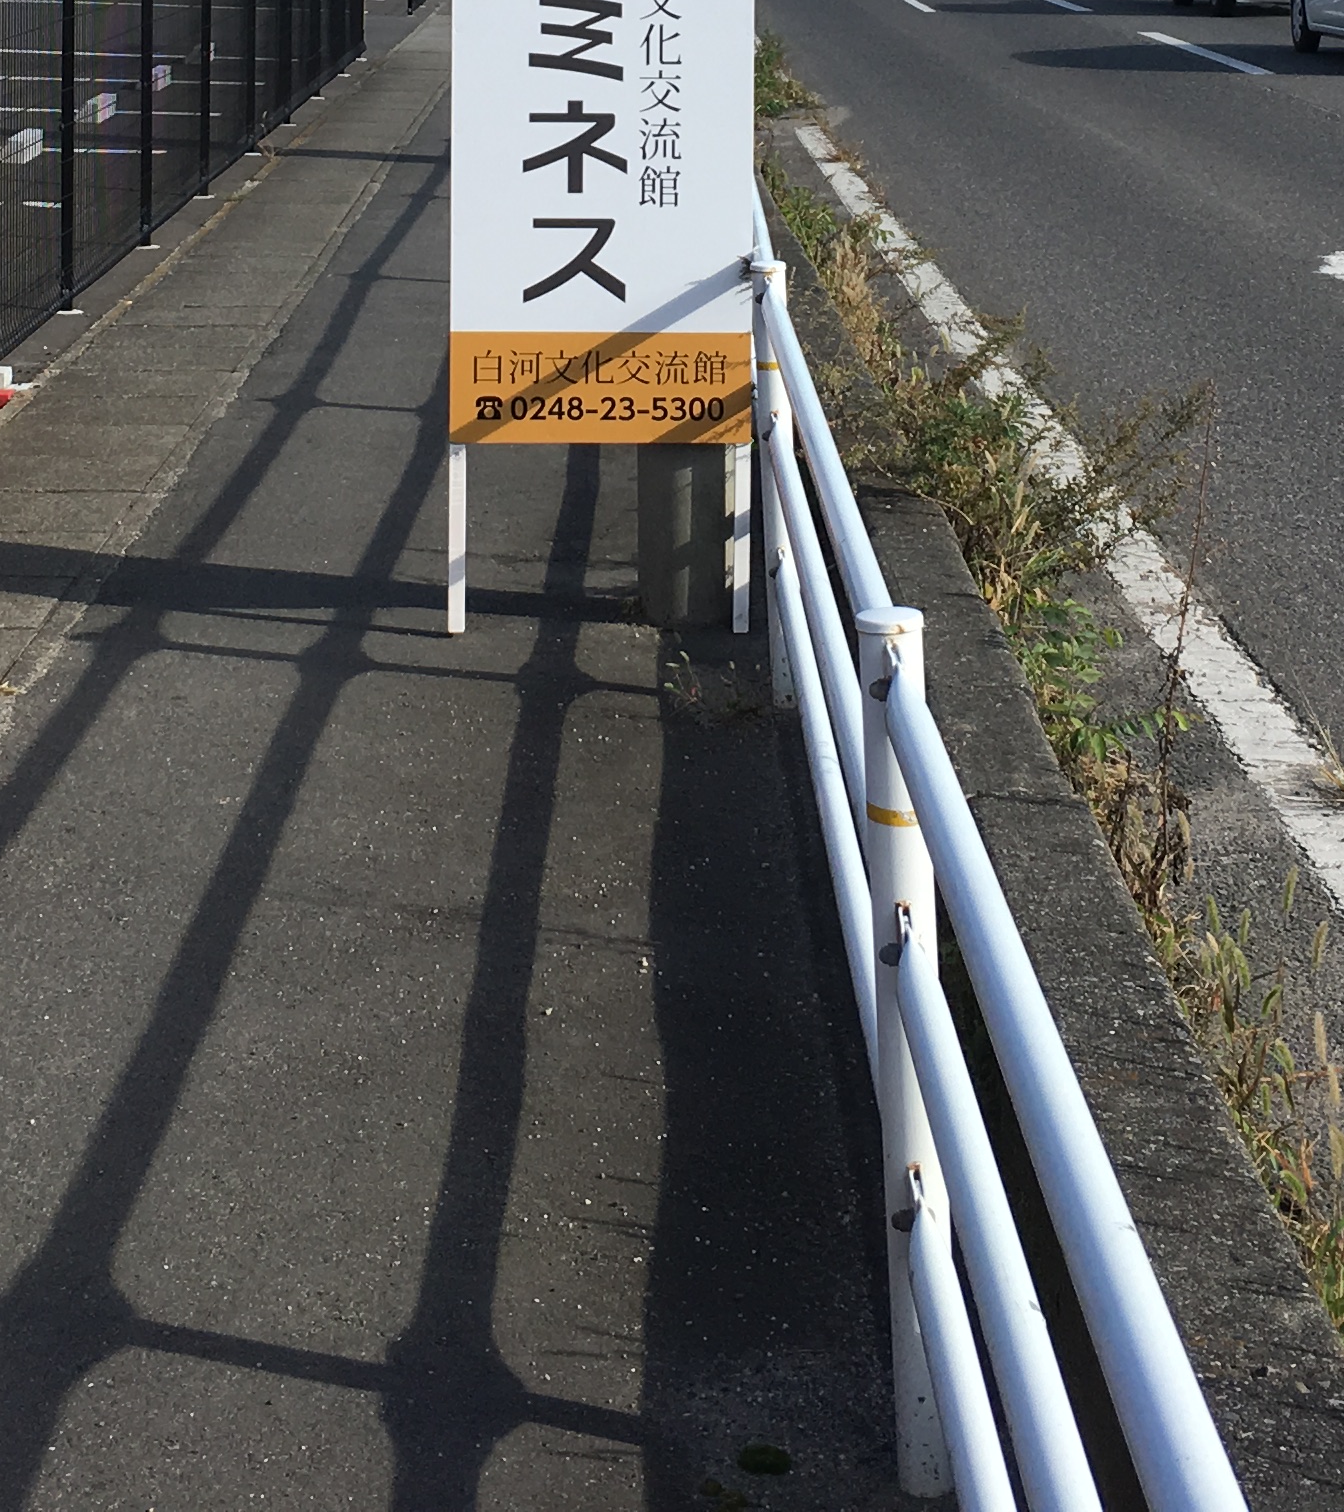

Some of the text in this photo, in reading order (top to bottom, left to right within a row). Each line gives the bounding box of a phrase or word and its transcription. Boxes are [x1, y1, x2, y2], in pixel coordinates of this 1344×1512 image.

[472, 349, 727, 386] 白河文化交流館
[510, 396, 725, 421] 0248-23-5300
